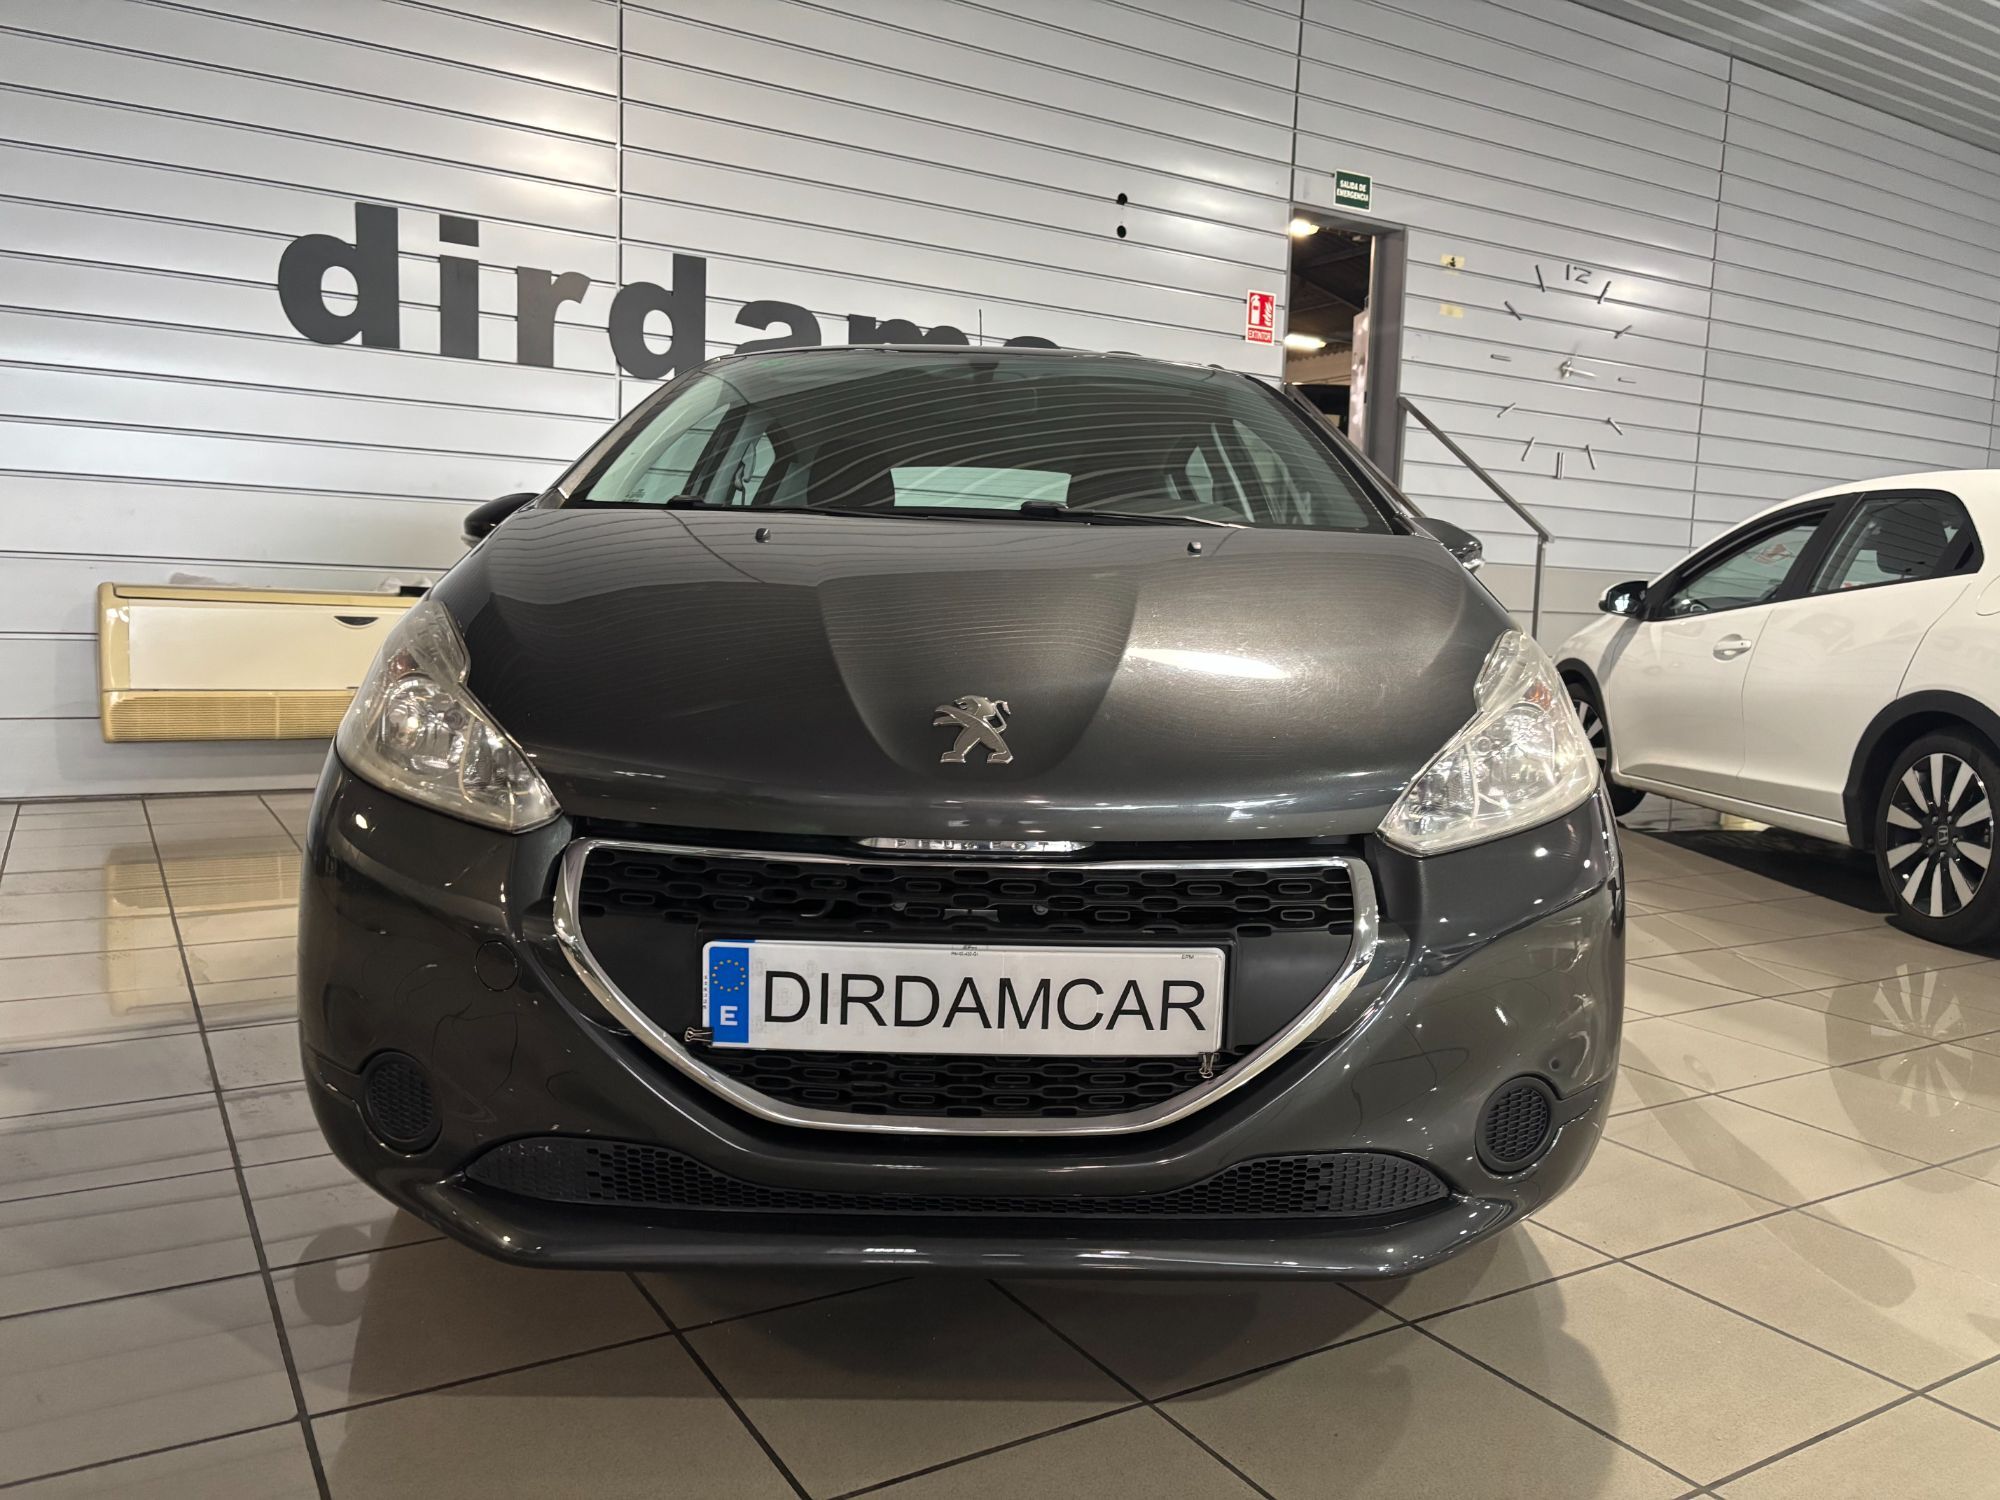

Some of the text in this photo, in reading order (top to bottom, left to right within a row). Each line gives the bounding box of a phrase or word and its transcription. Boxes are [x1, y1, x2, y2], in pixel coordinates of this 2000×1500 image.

[1340, 179, 1366, 192] SALIDA DE
[1336, 188, 1369, 201] EMERGENCIA
[720, 970, 1206, 1031] E DIRDAMCAR
